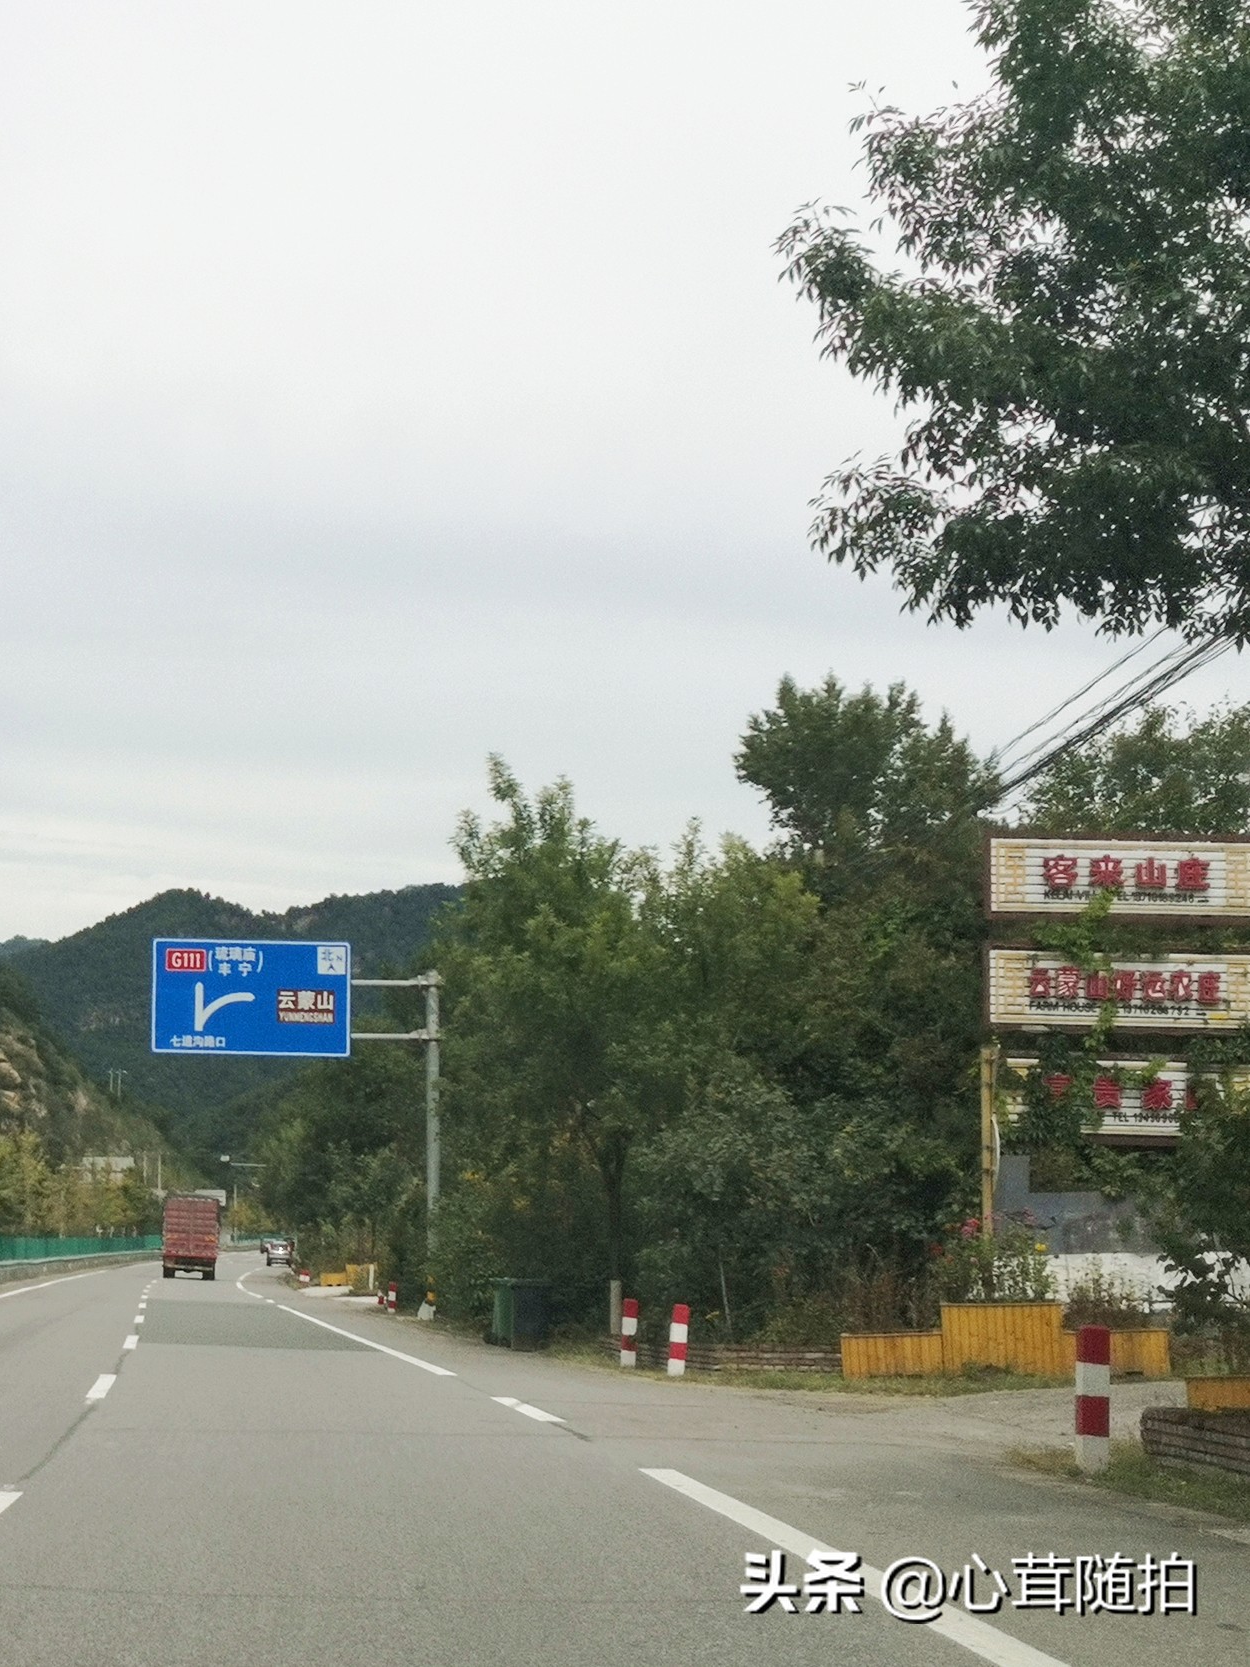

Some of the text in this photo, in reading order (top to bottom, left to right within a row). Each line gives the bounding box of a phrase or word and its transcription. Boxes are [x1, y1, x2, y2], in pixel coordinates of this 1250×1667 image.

[171, 951, 201, 968] G111
[278, 990, 334, 1010] 云蒙山
[1028, 1000, 1059, 1011] FARM
[1062, 1001, 1097, 1013] HOUSE
